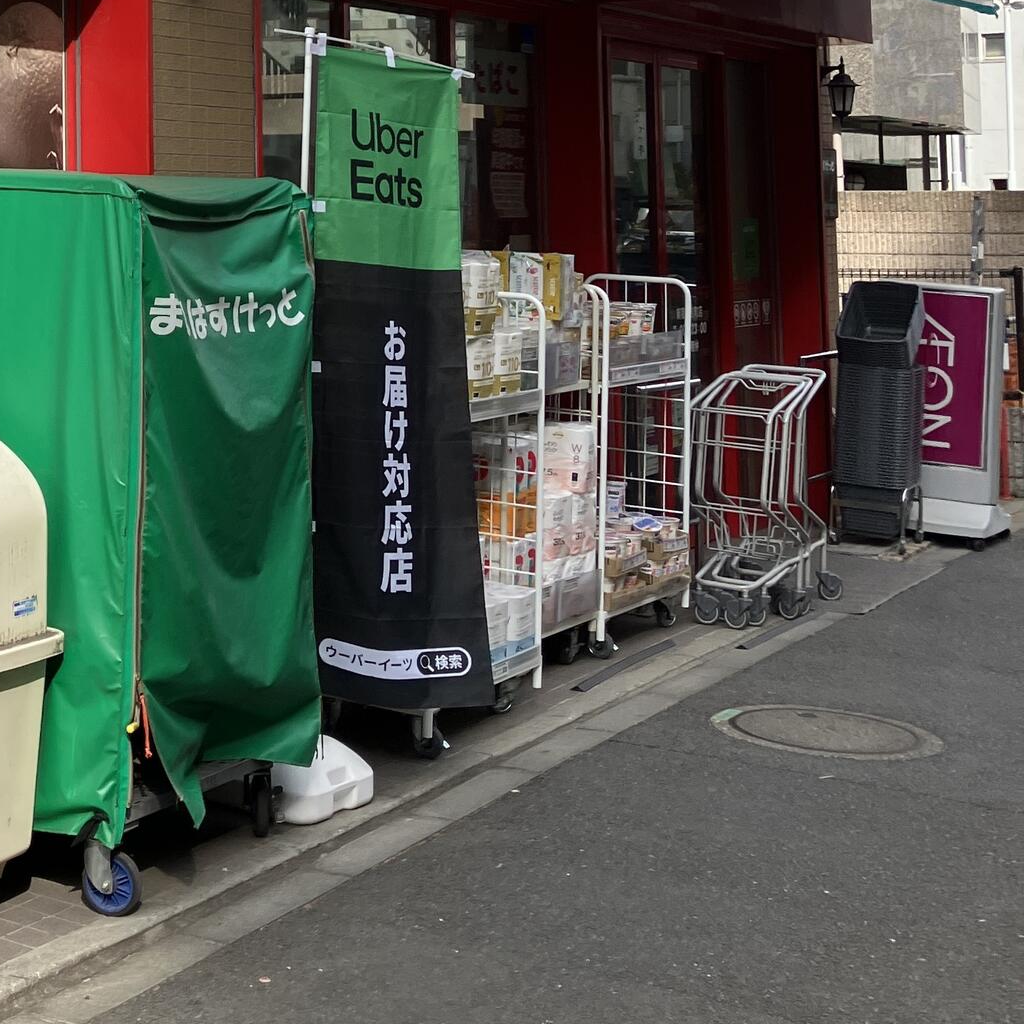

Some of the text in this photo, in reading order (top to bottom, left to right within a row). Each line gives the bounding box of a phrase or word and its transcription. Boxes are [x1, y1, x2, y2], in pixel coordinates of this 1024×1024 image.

[351, 108, 424, 159] Uber
[350, 159, 423, 208] Eats
[380, 320, 413, 593] お届け対応店
[326, 645, 462, 671] ウーバーイーツ 検索
